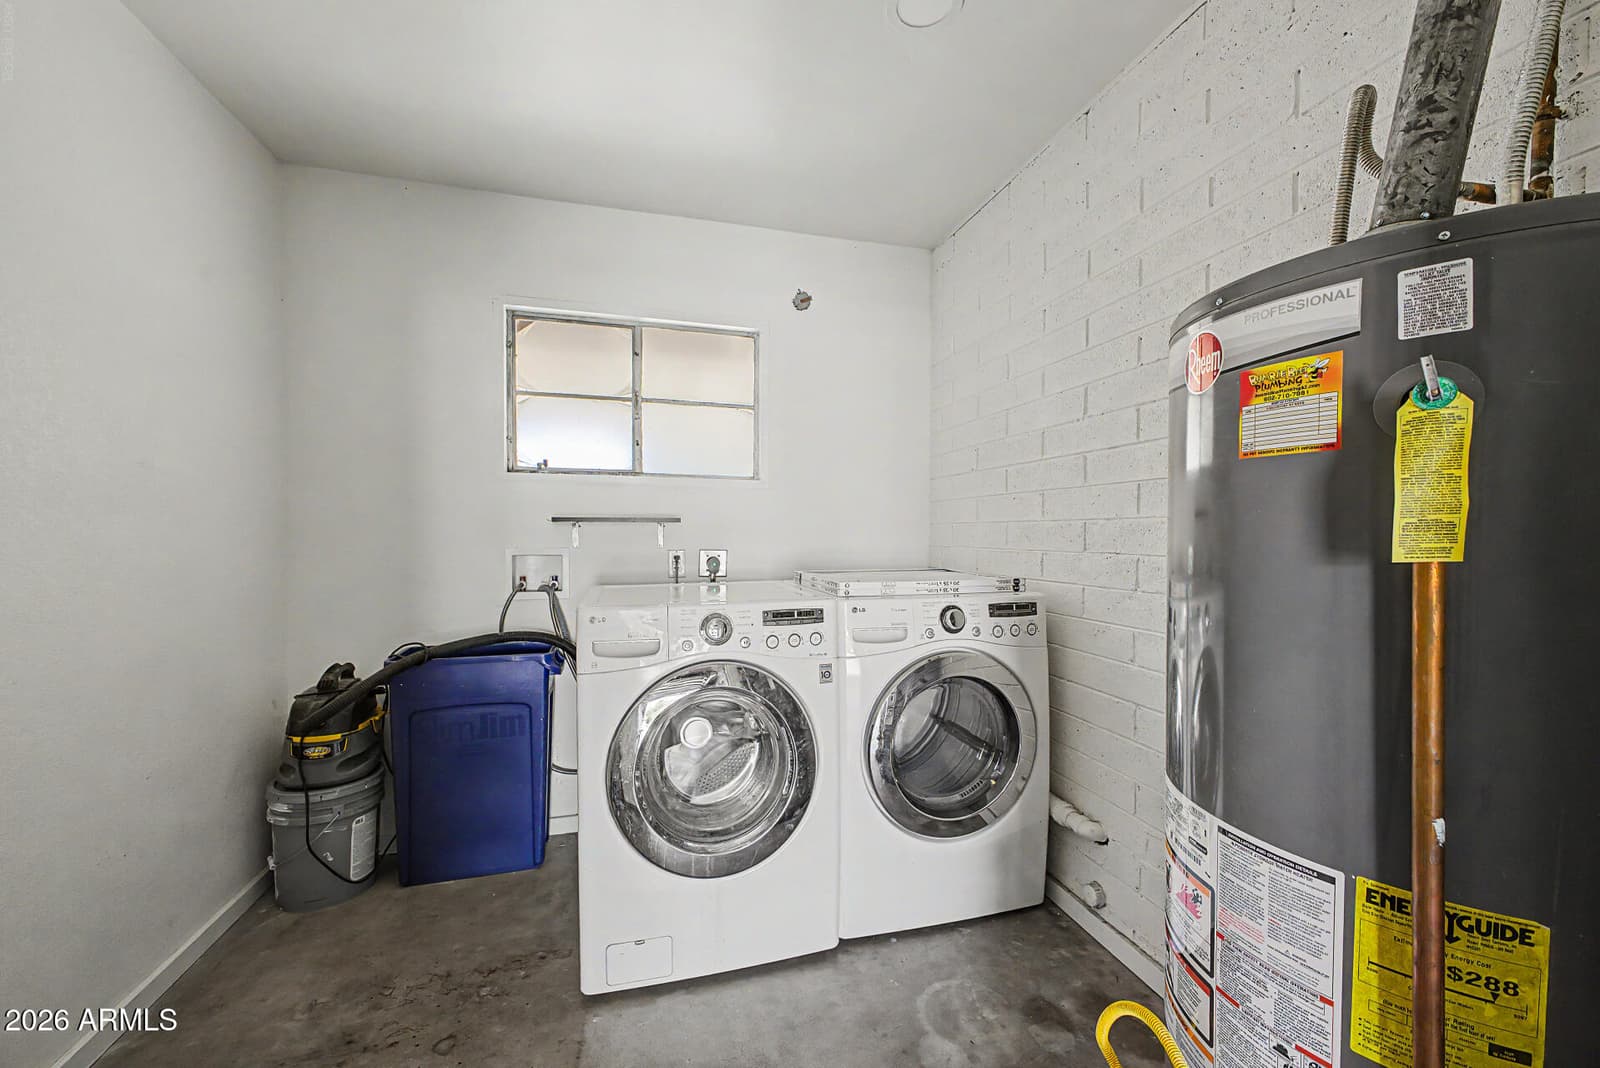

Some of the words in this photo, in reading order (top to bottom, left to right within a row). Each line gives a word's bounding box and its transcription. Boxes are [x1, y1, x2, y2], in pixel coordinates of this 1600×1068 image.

[1243, 287, 1356, 326] PROFESSIONAL
[1188, 349, 1221, 385] Rheem
[1366, 887, 1536, 947] ENEYGUIDE
[1450, 953, 1475, 966] Energy
[1446, 965, 1520, 997] $288
